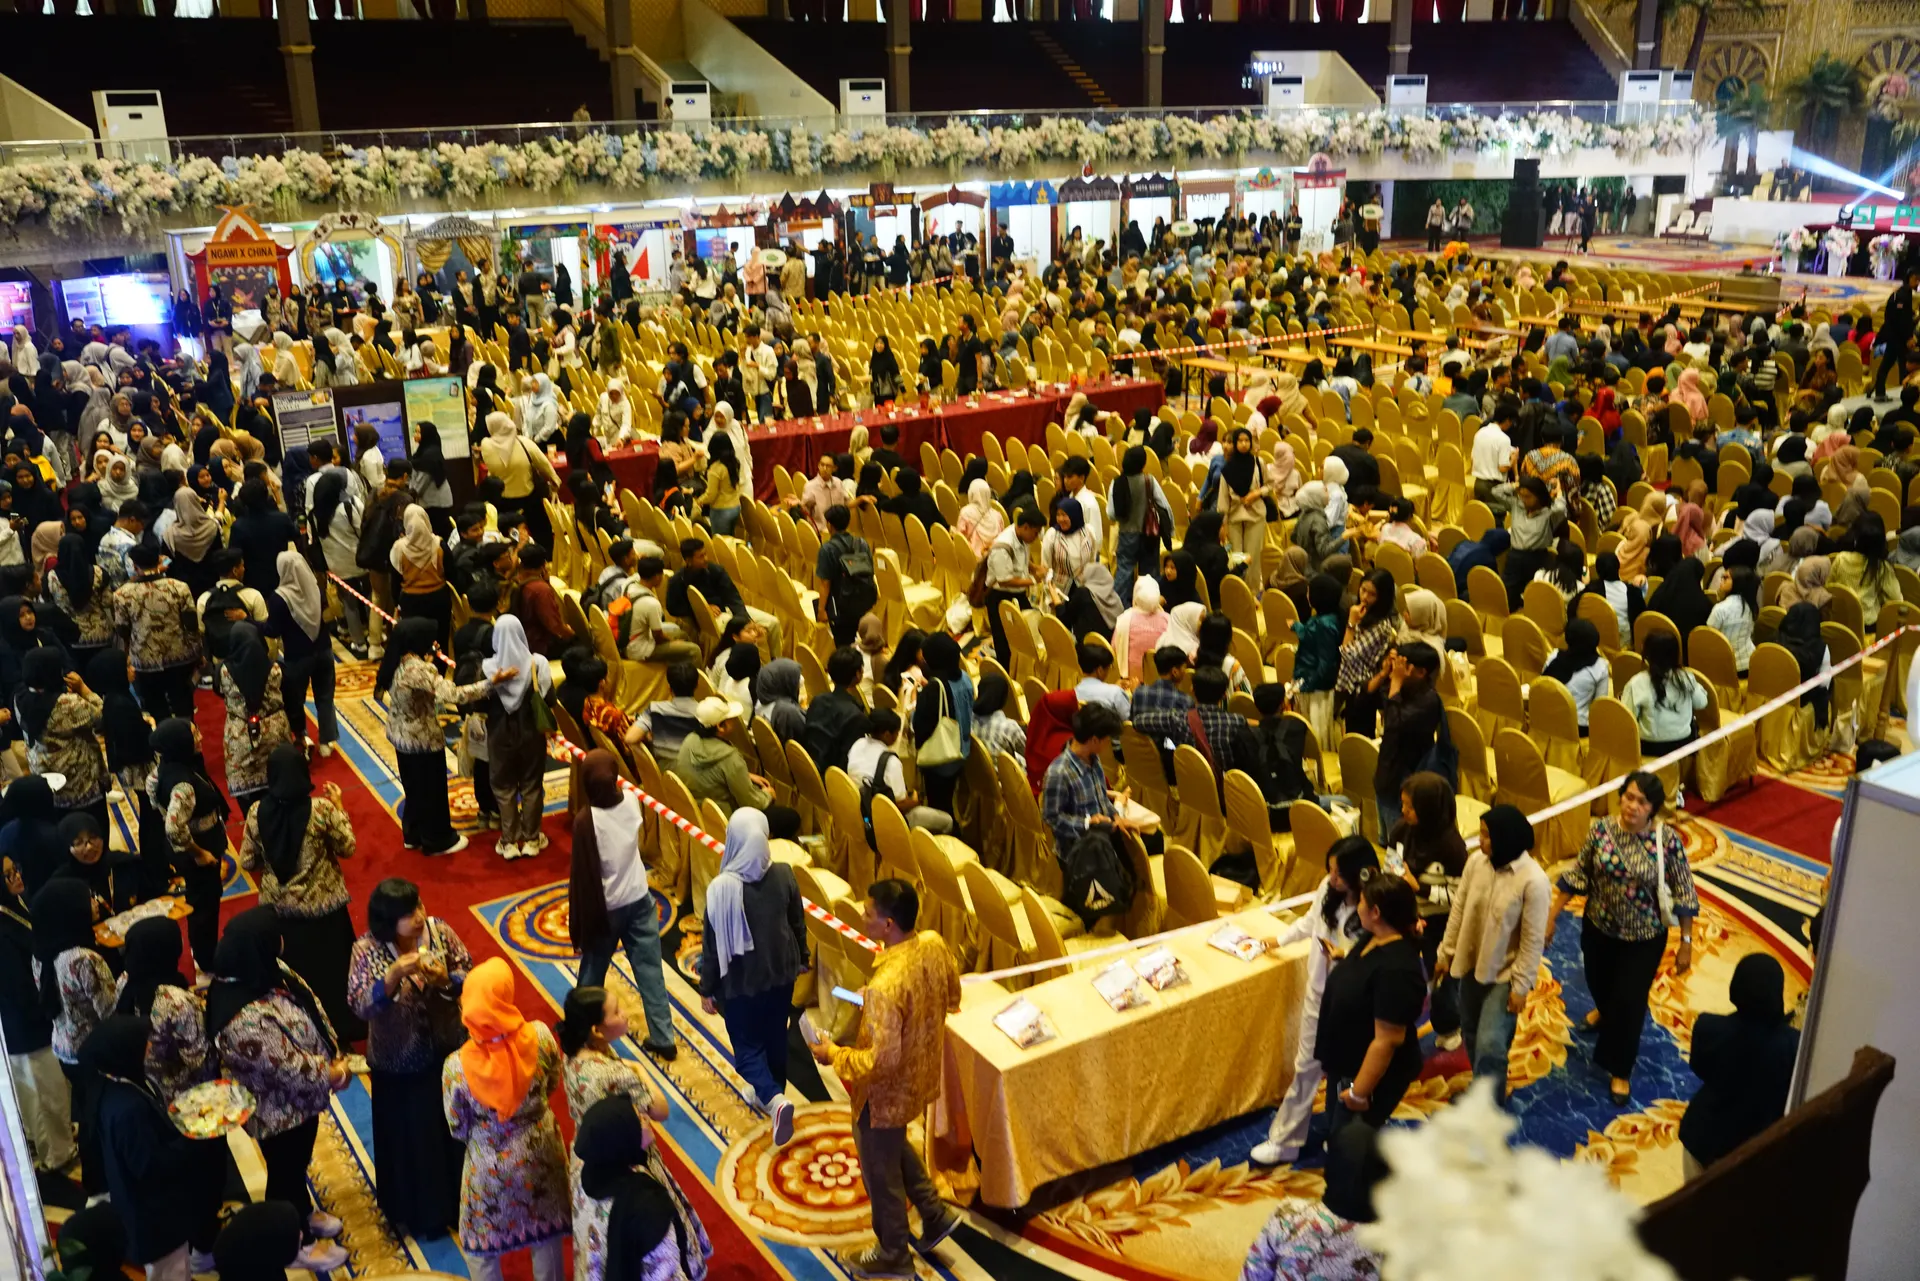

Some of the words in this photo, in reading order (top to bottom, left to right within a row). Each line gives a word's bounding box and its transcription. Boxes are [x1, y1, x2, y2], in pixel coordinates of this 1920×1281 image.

[1853, 205, 1877, 225] SI
[211, 248, 238, 259] NGAWI
[239, 248, 246, 258] X
[247, 247, 273, 257] CHINA
